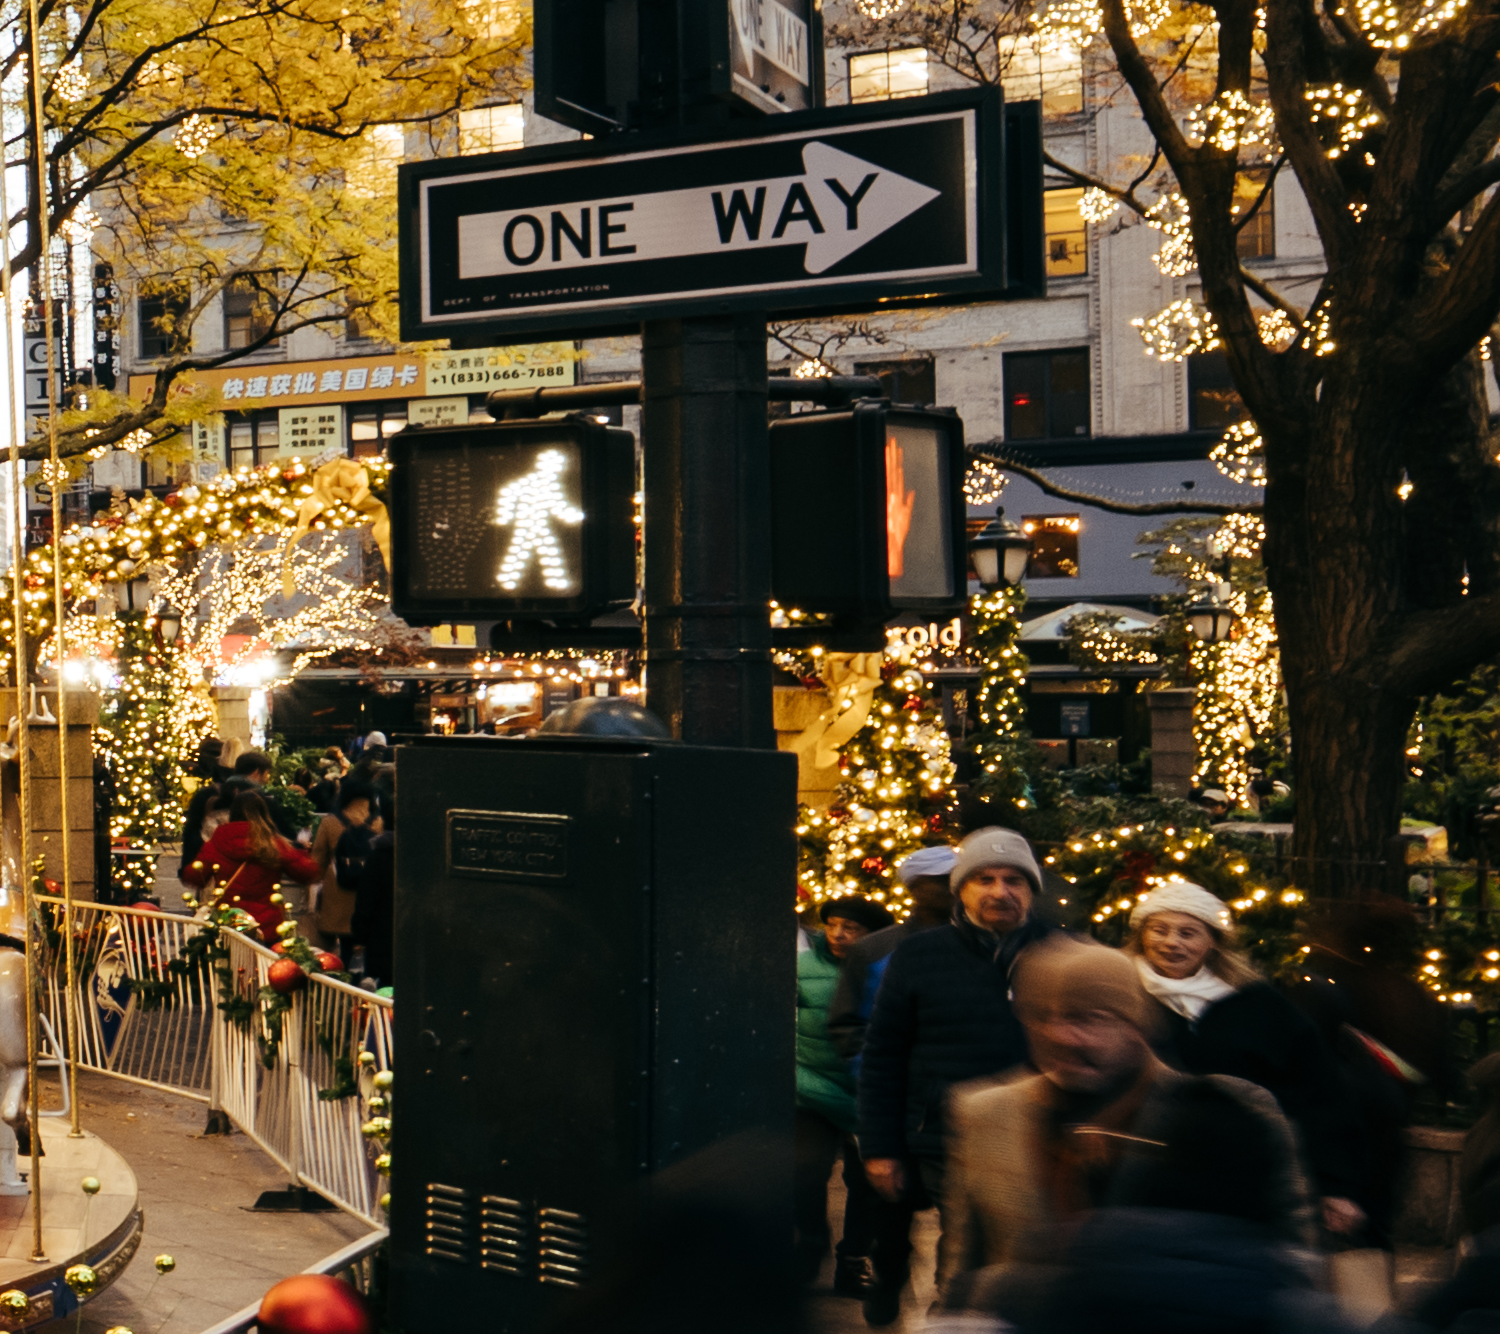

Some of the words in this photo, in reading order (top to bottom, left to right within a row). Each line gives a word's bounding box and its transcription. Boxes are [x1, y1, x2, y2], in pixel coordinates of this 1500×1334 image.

[774, 7, 803, 73] WAY
[502, 201, 638, 267] ONE
[710, 172, 880, 245] WAY
[443, 298, 471, 307] DEPT
[509, 284, 610, 300] TRANSPORTATION
[222, 362, 419, 400] 快速获批美国绿卡
[454, 826, 503, 843] TRAFFIC
[506, 830, 564, 848] CONTROL
[460, 847, 488, 861] NEW
[491, 849, 523, 864] YORK
[525, 851, 556, 866] CITY
